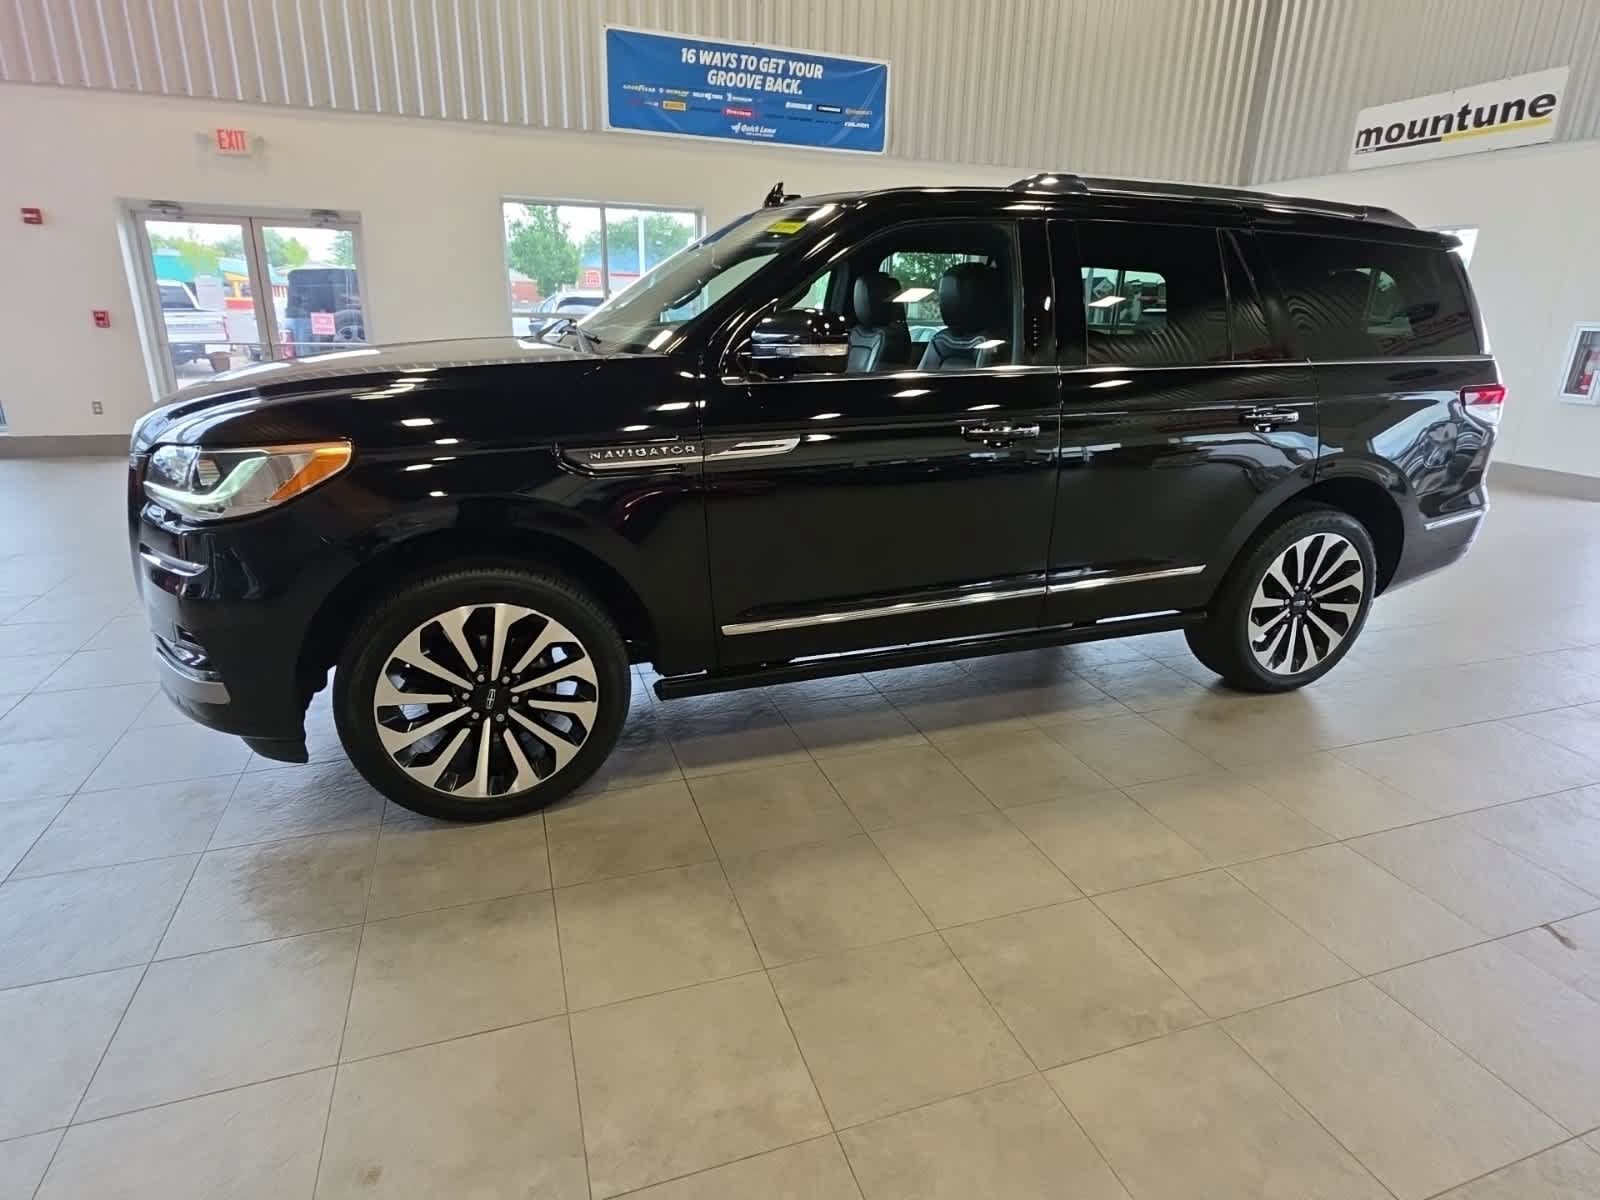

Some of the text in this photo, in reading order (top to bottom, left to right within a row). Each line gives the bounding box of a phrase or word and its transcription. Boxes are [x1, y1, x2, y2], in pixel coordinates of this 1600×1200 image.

[681, 47, 823, 79] 16 WAYS TO GET YOUR
[707, 69, 802, 95] GROOVE BACK.
[1355, 93, 1557, 149] mountune
[216, 129, 247, 151] EXIT
[590, 445, 697, 460] NAVIGATOR
